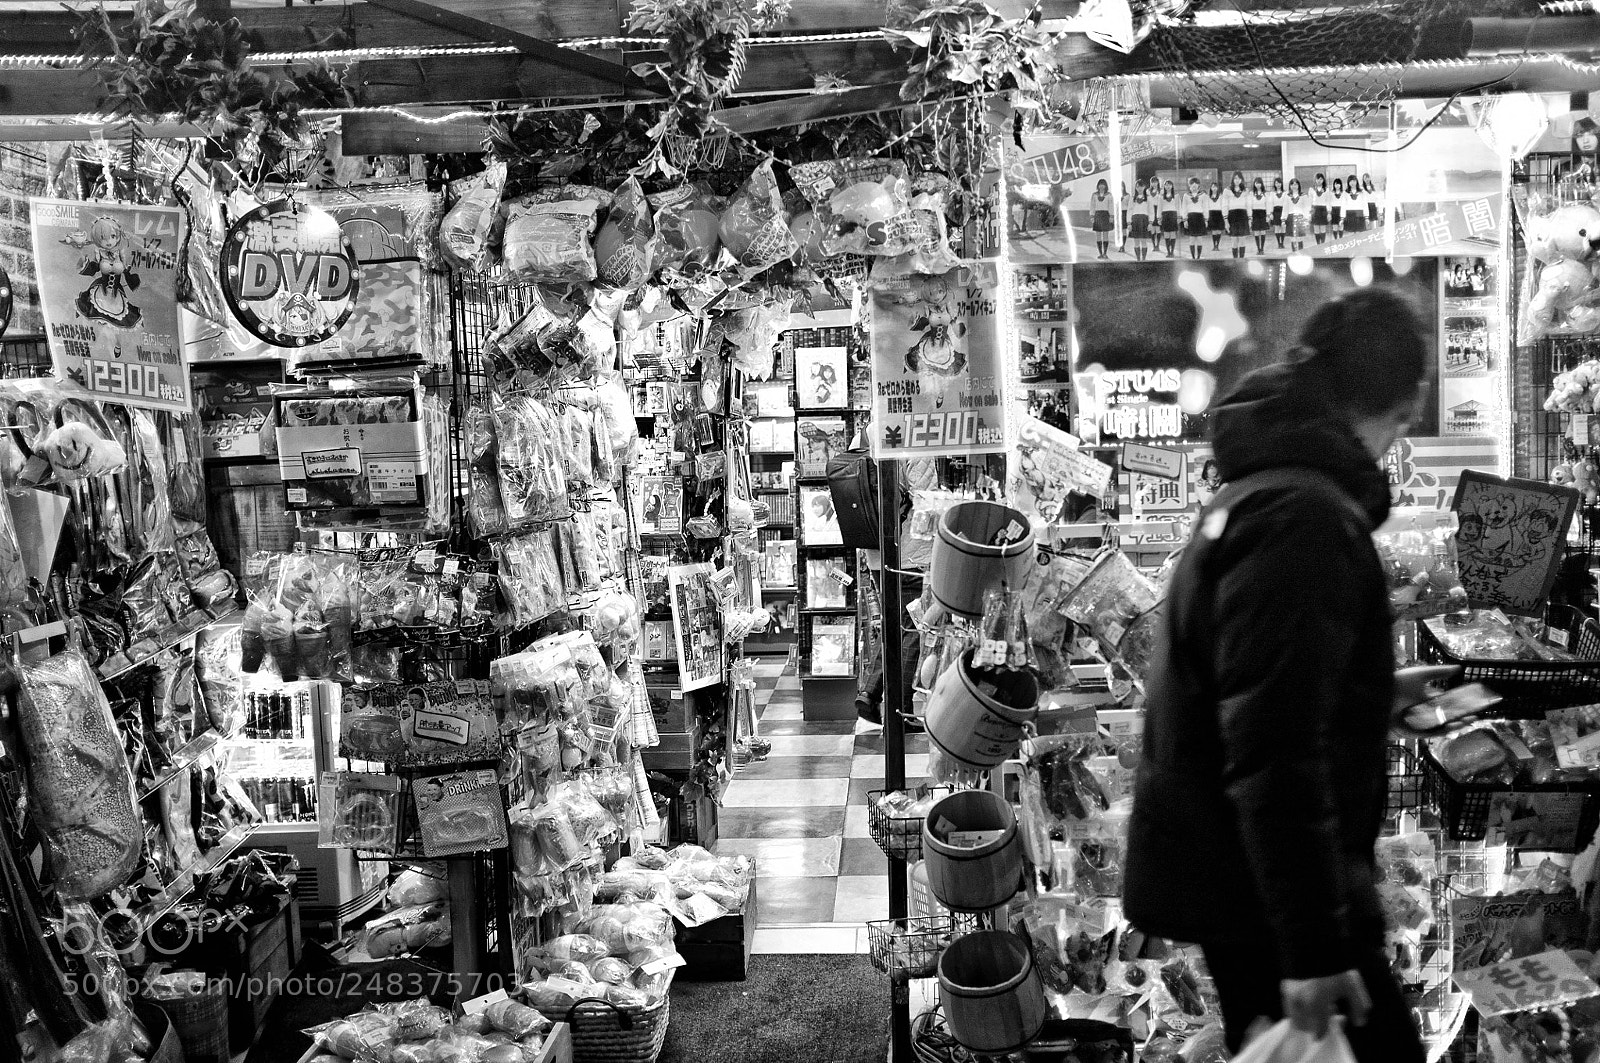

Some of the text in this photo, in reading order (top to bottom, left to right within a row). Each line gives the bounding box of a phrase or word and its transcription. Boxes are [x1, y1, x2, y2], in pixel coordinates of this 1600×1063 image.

[1010, 143, 1095, 185] STU48
[55, 205, 79, 218] SMILE
[1419, 198, 1496, 246] 暗闇
[134, 213, 176, 237] レム
[143, 237, 162, 249] 1/7
[240, 252, 352, 299] DVD
[966, 288, 983, 298] 1/7
[141, 332, 173, 347] 店内にて
[137, 345, 151, 362] Now
[153, 351, 161, 363] on
[66, 359, 159, 398] ¥12300
[964, 375, 996, 390] 店内にて
[1101, 369, 1181, 393] STU48
[959, 391, 973, 408] Now
[974, 394, 983, 407] on
[885, 410, 979, 448] ¥12300
